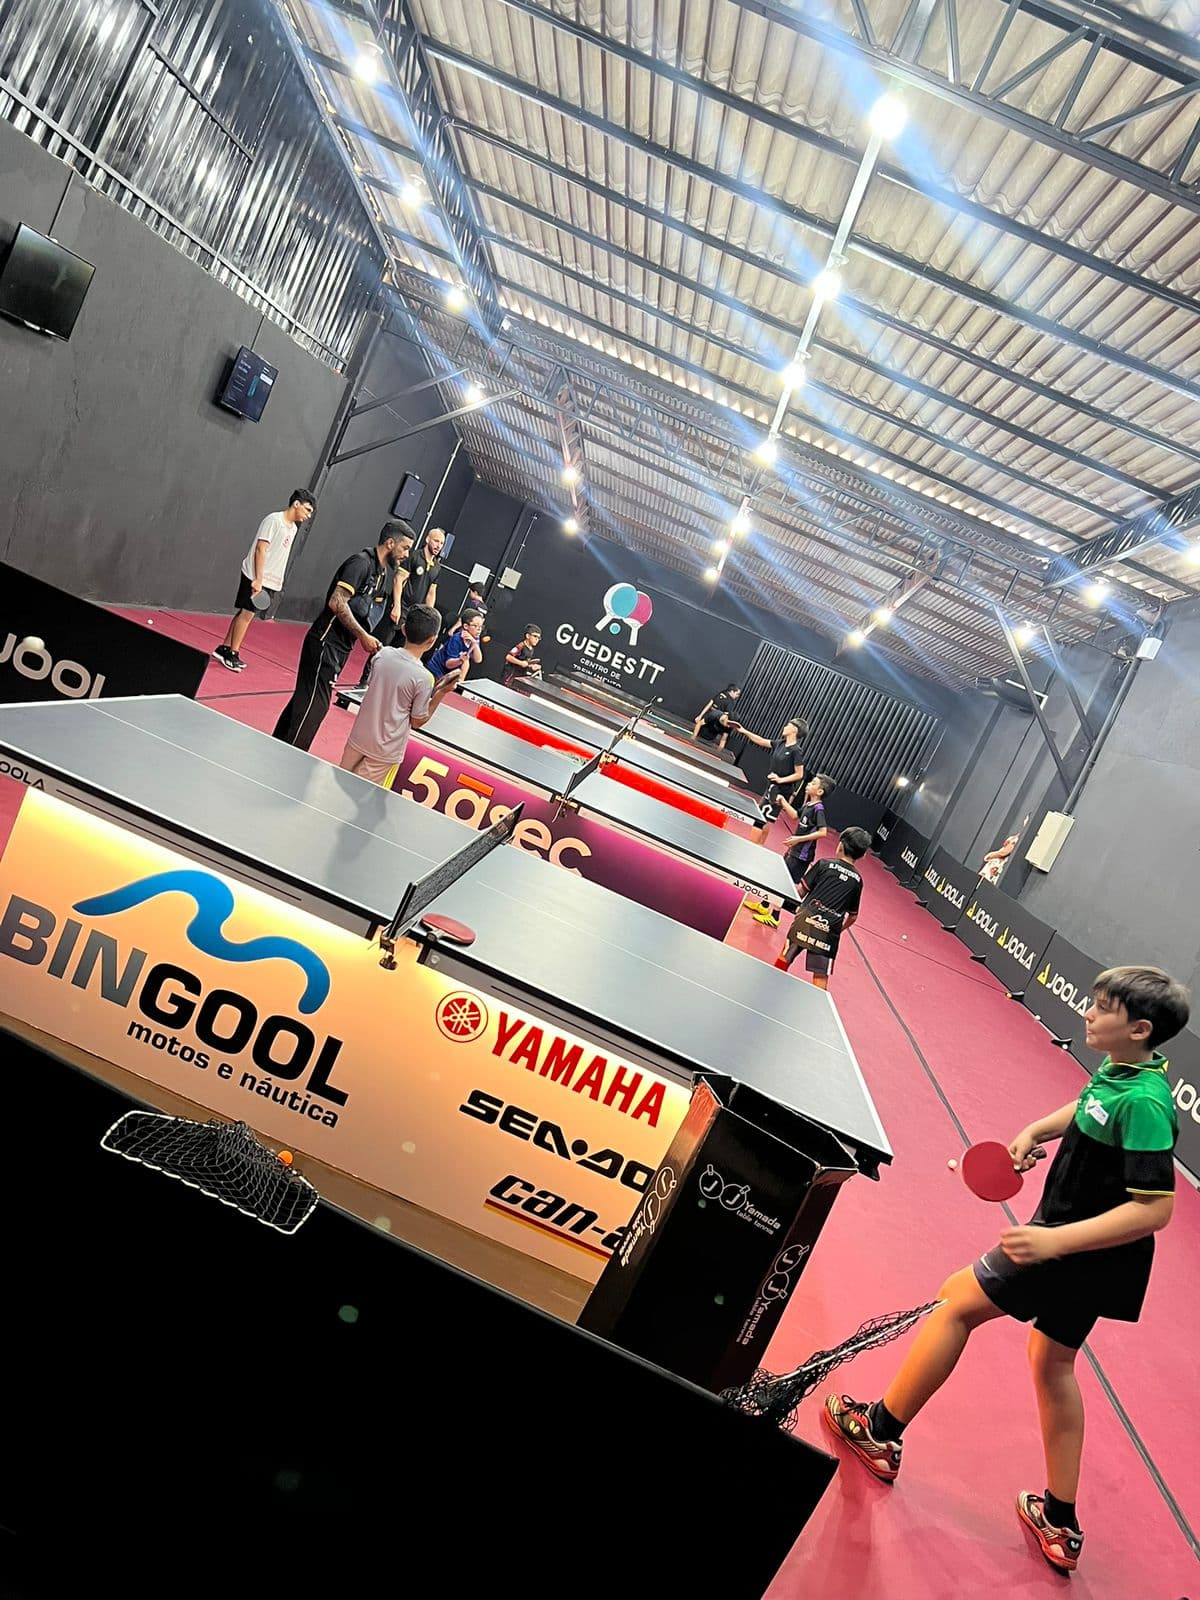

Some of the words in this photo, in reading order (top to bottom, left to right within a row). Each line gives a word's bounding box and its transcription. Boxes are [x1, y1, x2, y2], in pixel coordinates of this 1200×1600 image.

[580, 658, 609, 674] CENTRO
[610, 671, 621, 680] DE
[740, 882, 769, 900] JOOLA
[941, 883, 965, 910] JOOLA
[972, 907, 999, 938] JOOLA
[1003, 934, 1035, 970] JOOLA
[0, 894, 349, 1107] BINGOOL
[1045, 973, 1090, 1017] JOOLA
[126, 1020, 210, 1070] motos
[216, 1061, 234, 1081] e
[238, 1070, 340, 1128] náutica
[491, 1011, 667, 1128] YAMAHA
[736, 1209, 753, 1223] table
[753, 1219, 775, 1235] tennis
[744, 1201, 781, 1230] Yamada
[742, 1300, 772, 1345] Yamada
